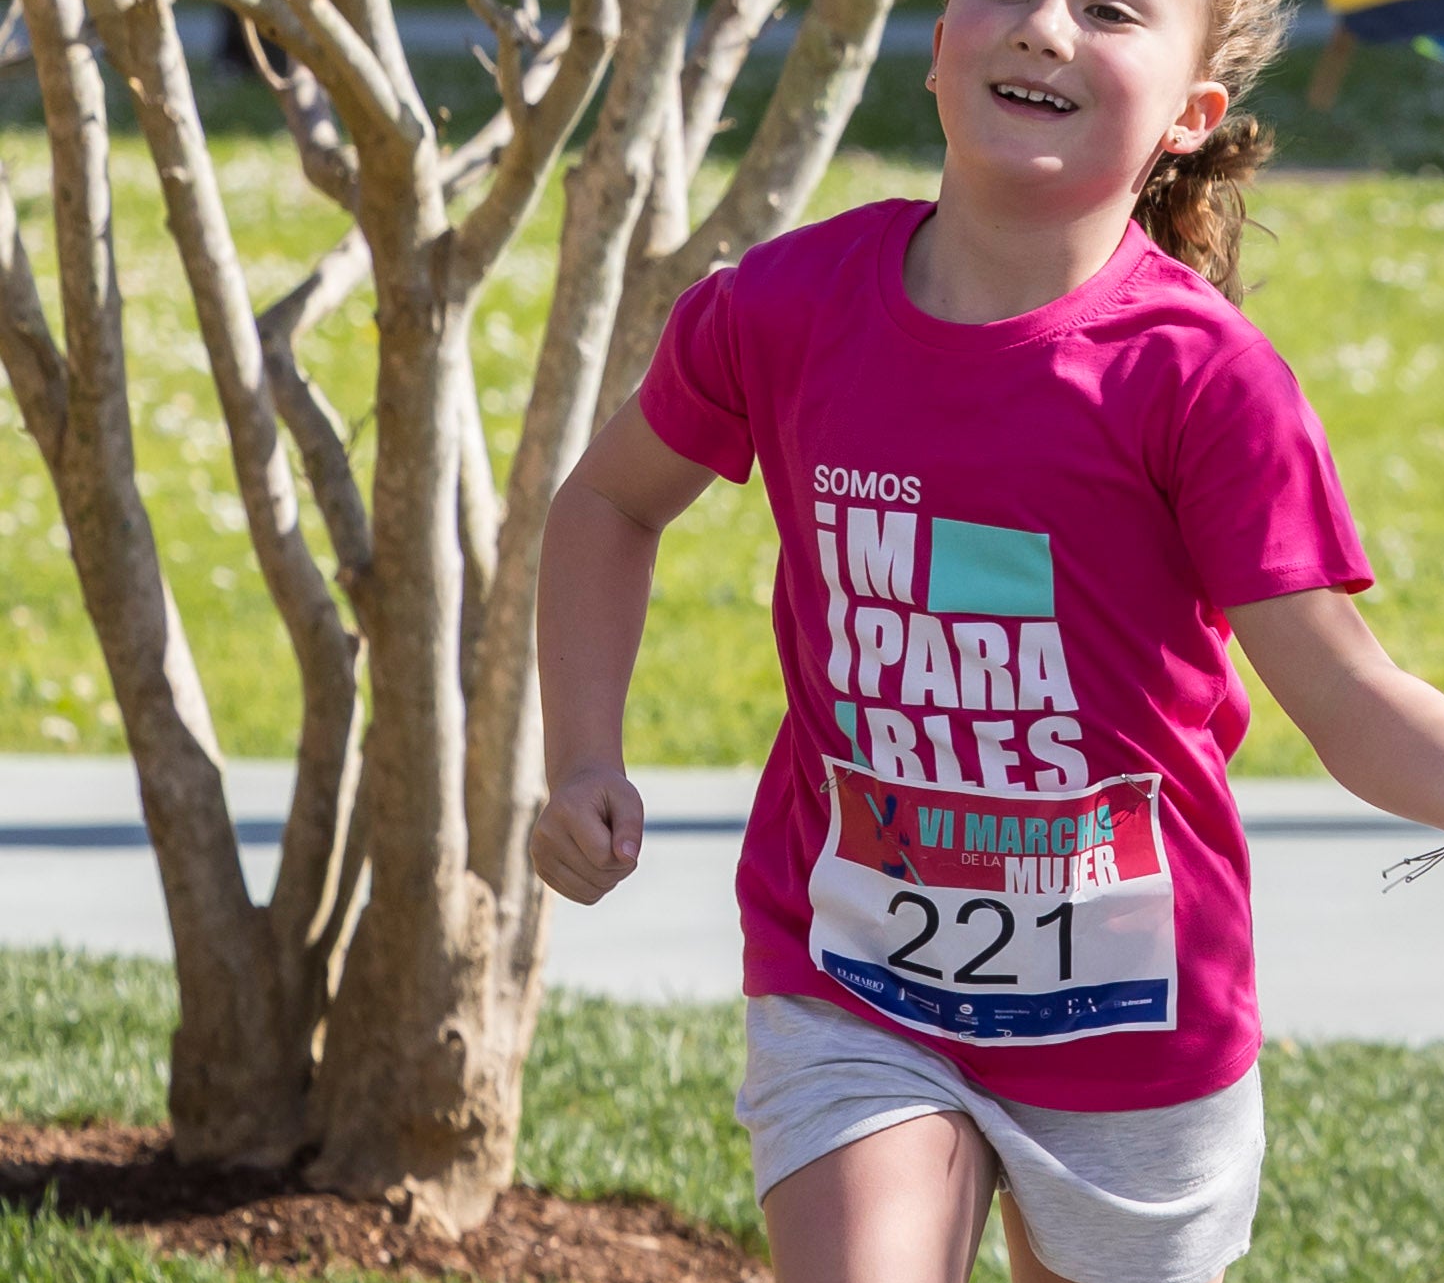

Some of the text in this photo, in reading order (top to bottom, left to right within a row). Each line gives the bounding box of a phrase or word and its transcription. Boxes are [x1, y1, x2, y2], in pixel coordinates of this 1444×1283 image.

[813, 464, 921, 505] SOMOS
[916, 804, 1115, 856] VI MARCHA
[960, 844, 1122, 896] DE LA MUJER
[886, 890, 1075, 986] 221
